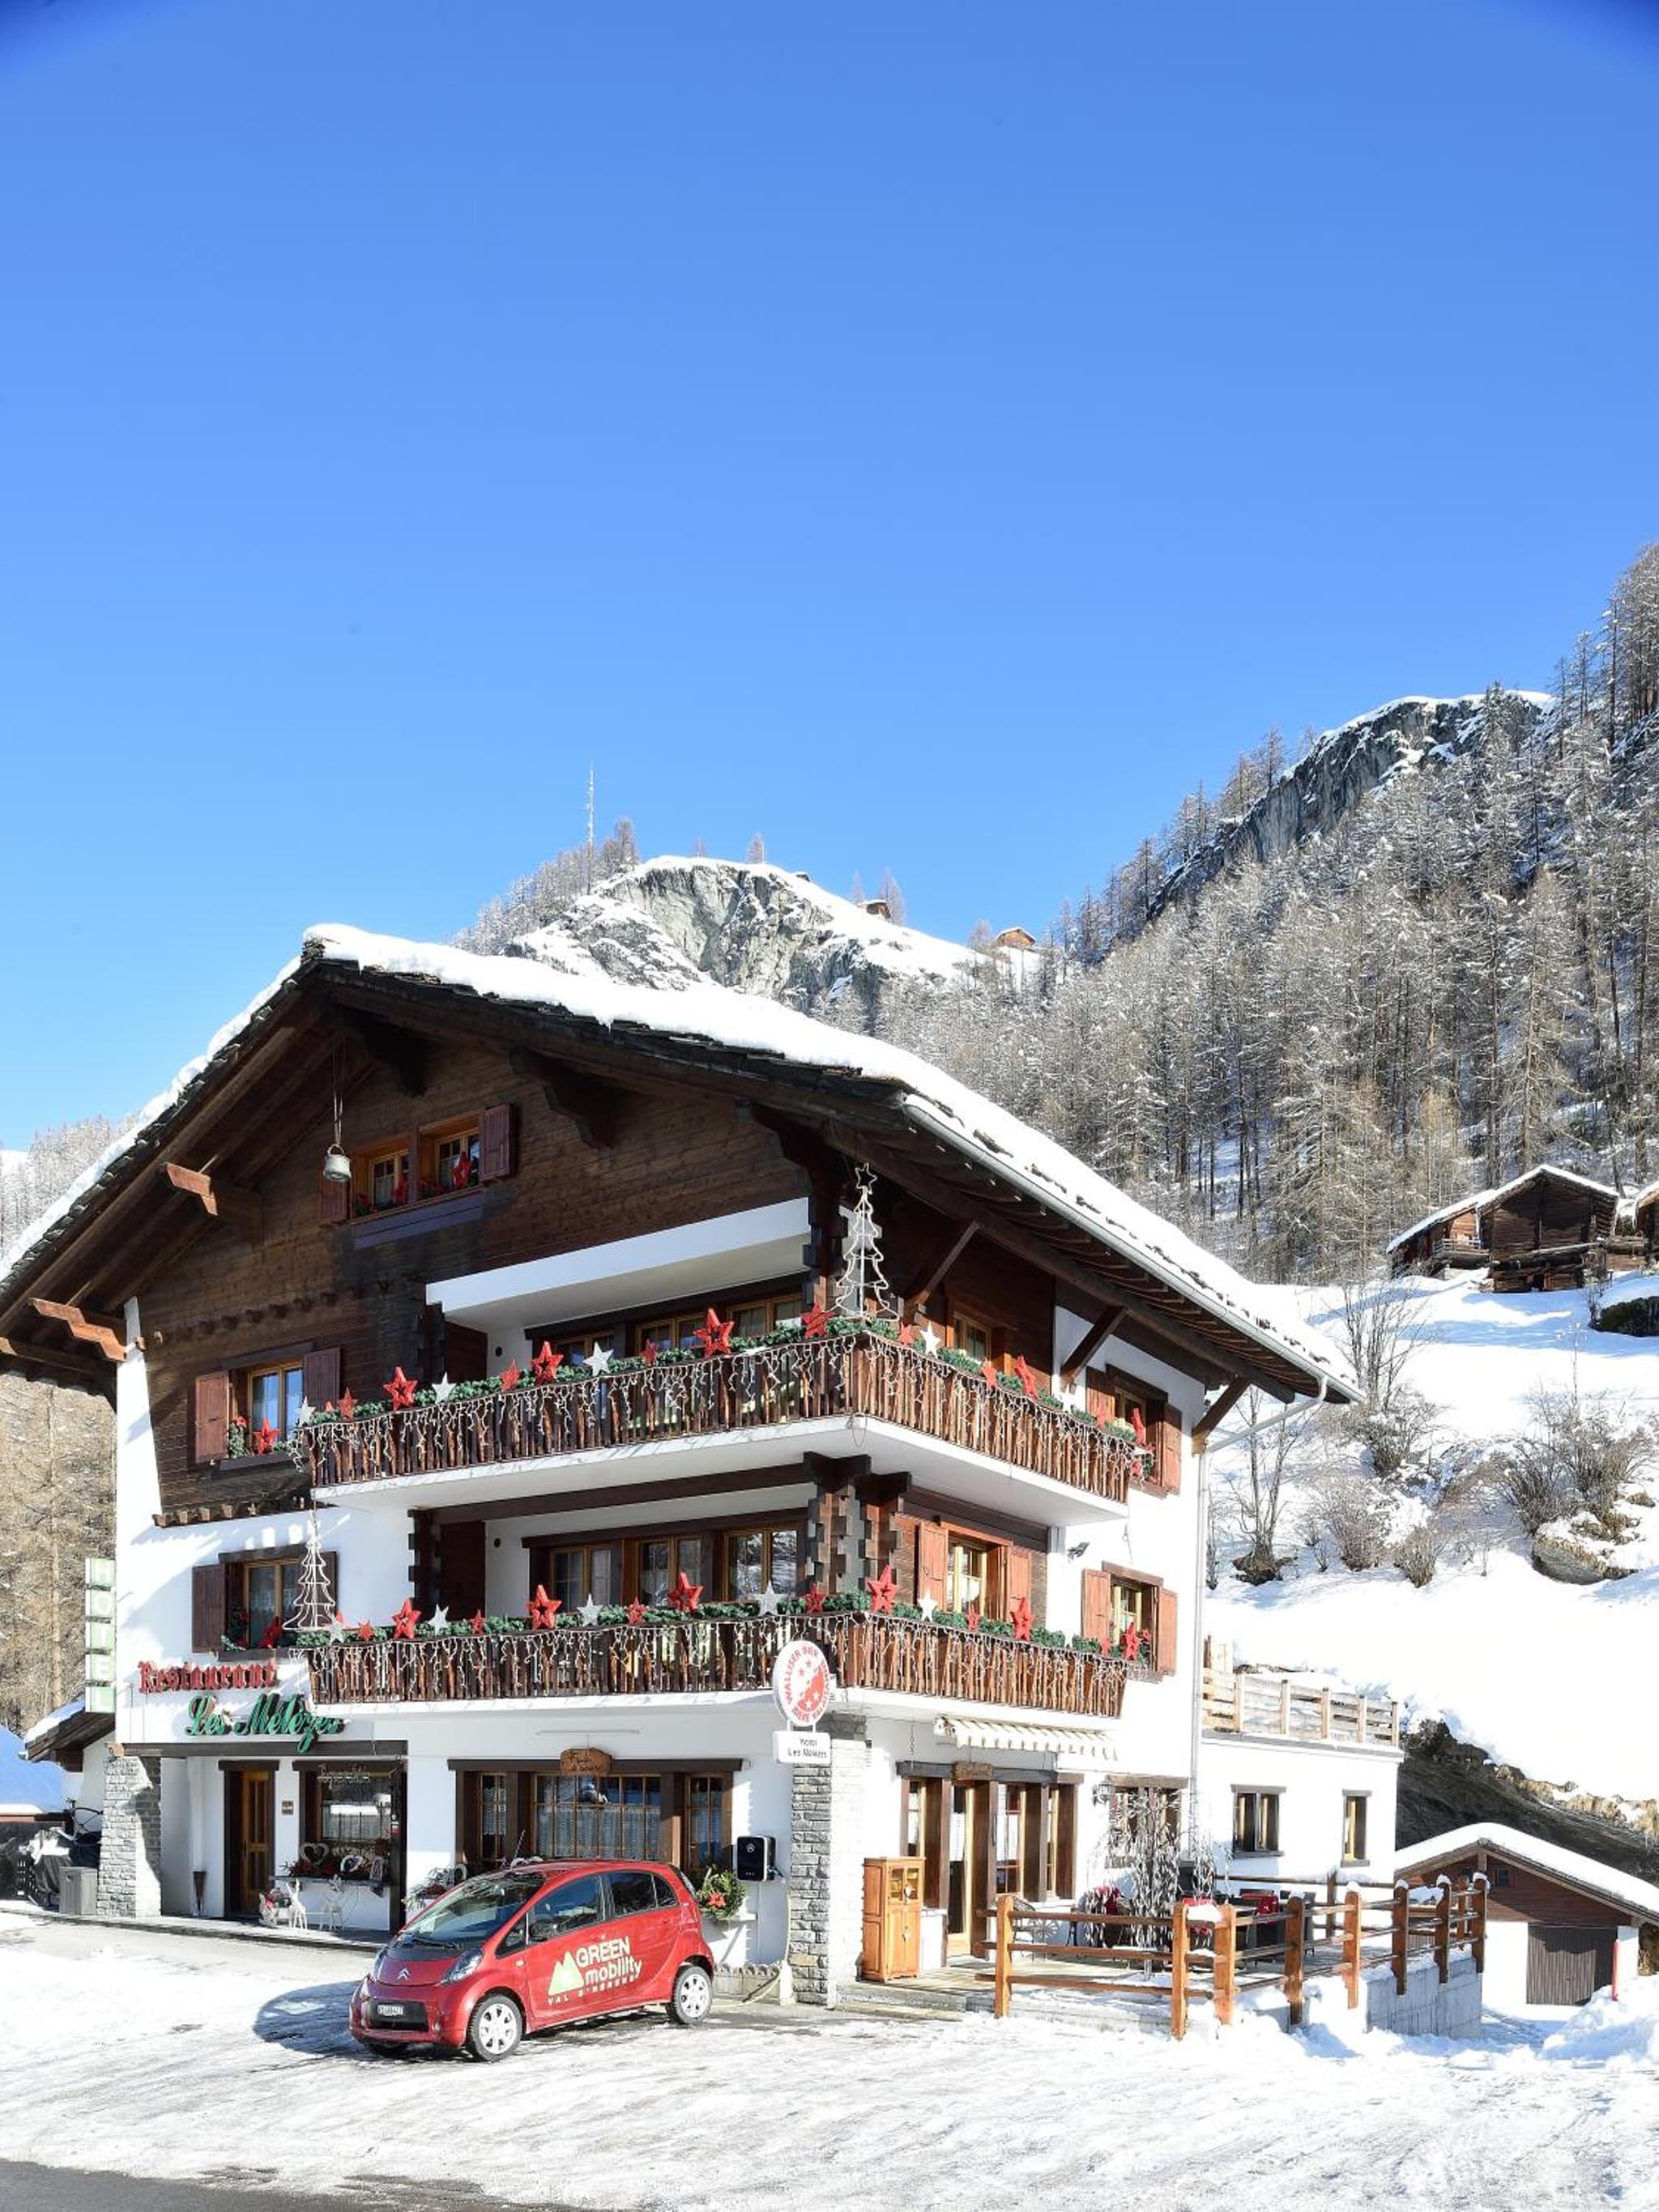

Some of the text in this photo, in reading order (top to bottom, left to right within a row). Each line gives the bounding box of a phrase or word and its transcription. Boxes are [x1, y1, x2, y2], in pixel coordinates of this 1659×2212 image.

[92, 1558, 114, 1711] HOTEL
[139, 1659, 278, 1693] Restaurant
[783, 1649, 802, 1704] WALLISER
[186, 1693, 228, 1736] Les
[576, 1936, 630, 1968] GREEN
[585, 1955, 642, 1986] mobility
[548, 1994, 569, 2005] VAL
